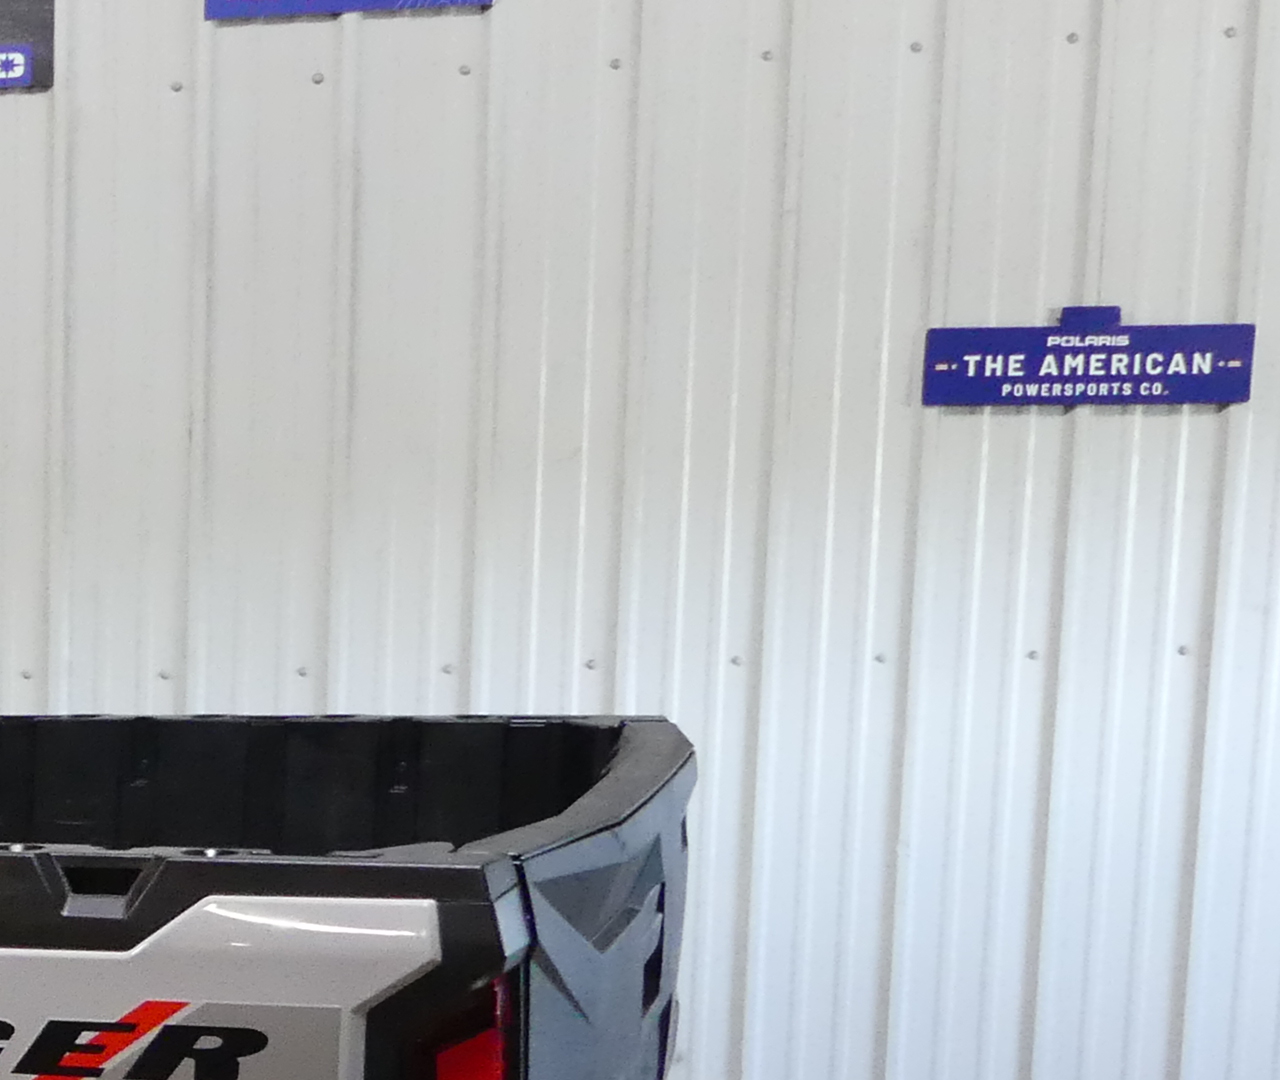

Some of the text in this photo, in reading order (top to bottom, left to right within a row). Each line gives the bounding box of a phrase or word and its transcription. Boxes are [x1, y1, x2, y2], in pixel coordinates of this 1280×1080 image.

[1046, 334, 1130, 348] POLARIS
[962, 352, 1213, 378] THE AMERICAN
[1001, 382, 1170, 397] POWERSPORTS CO.
